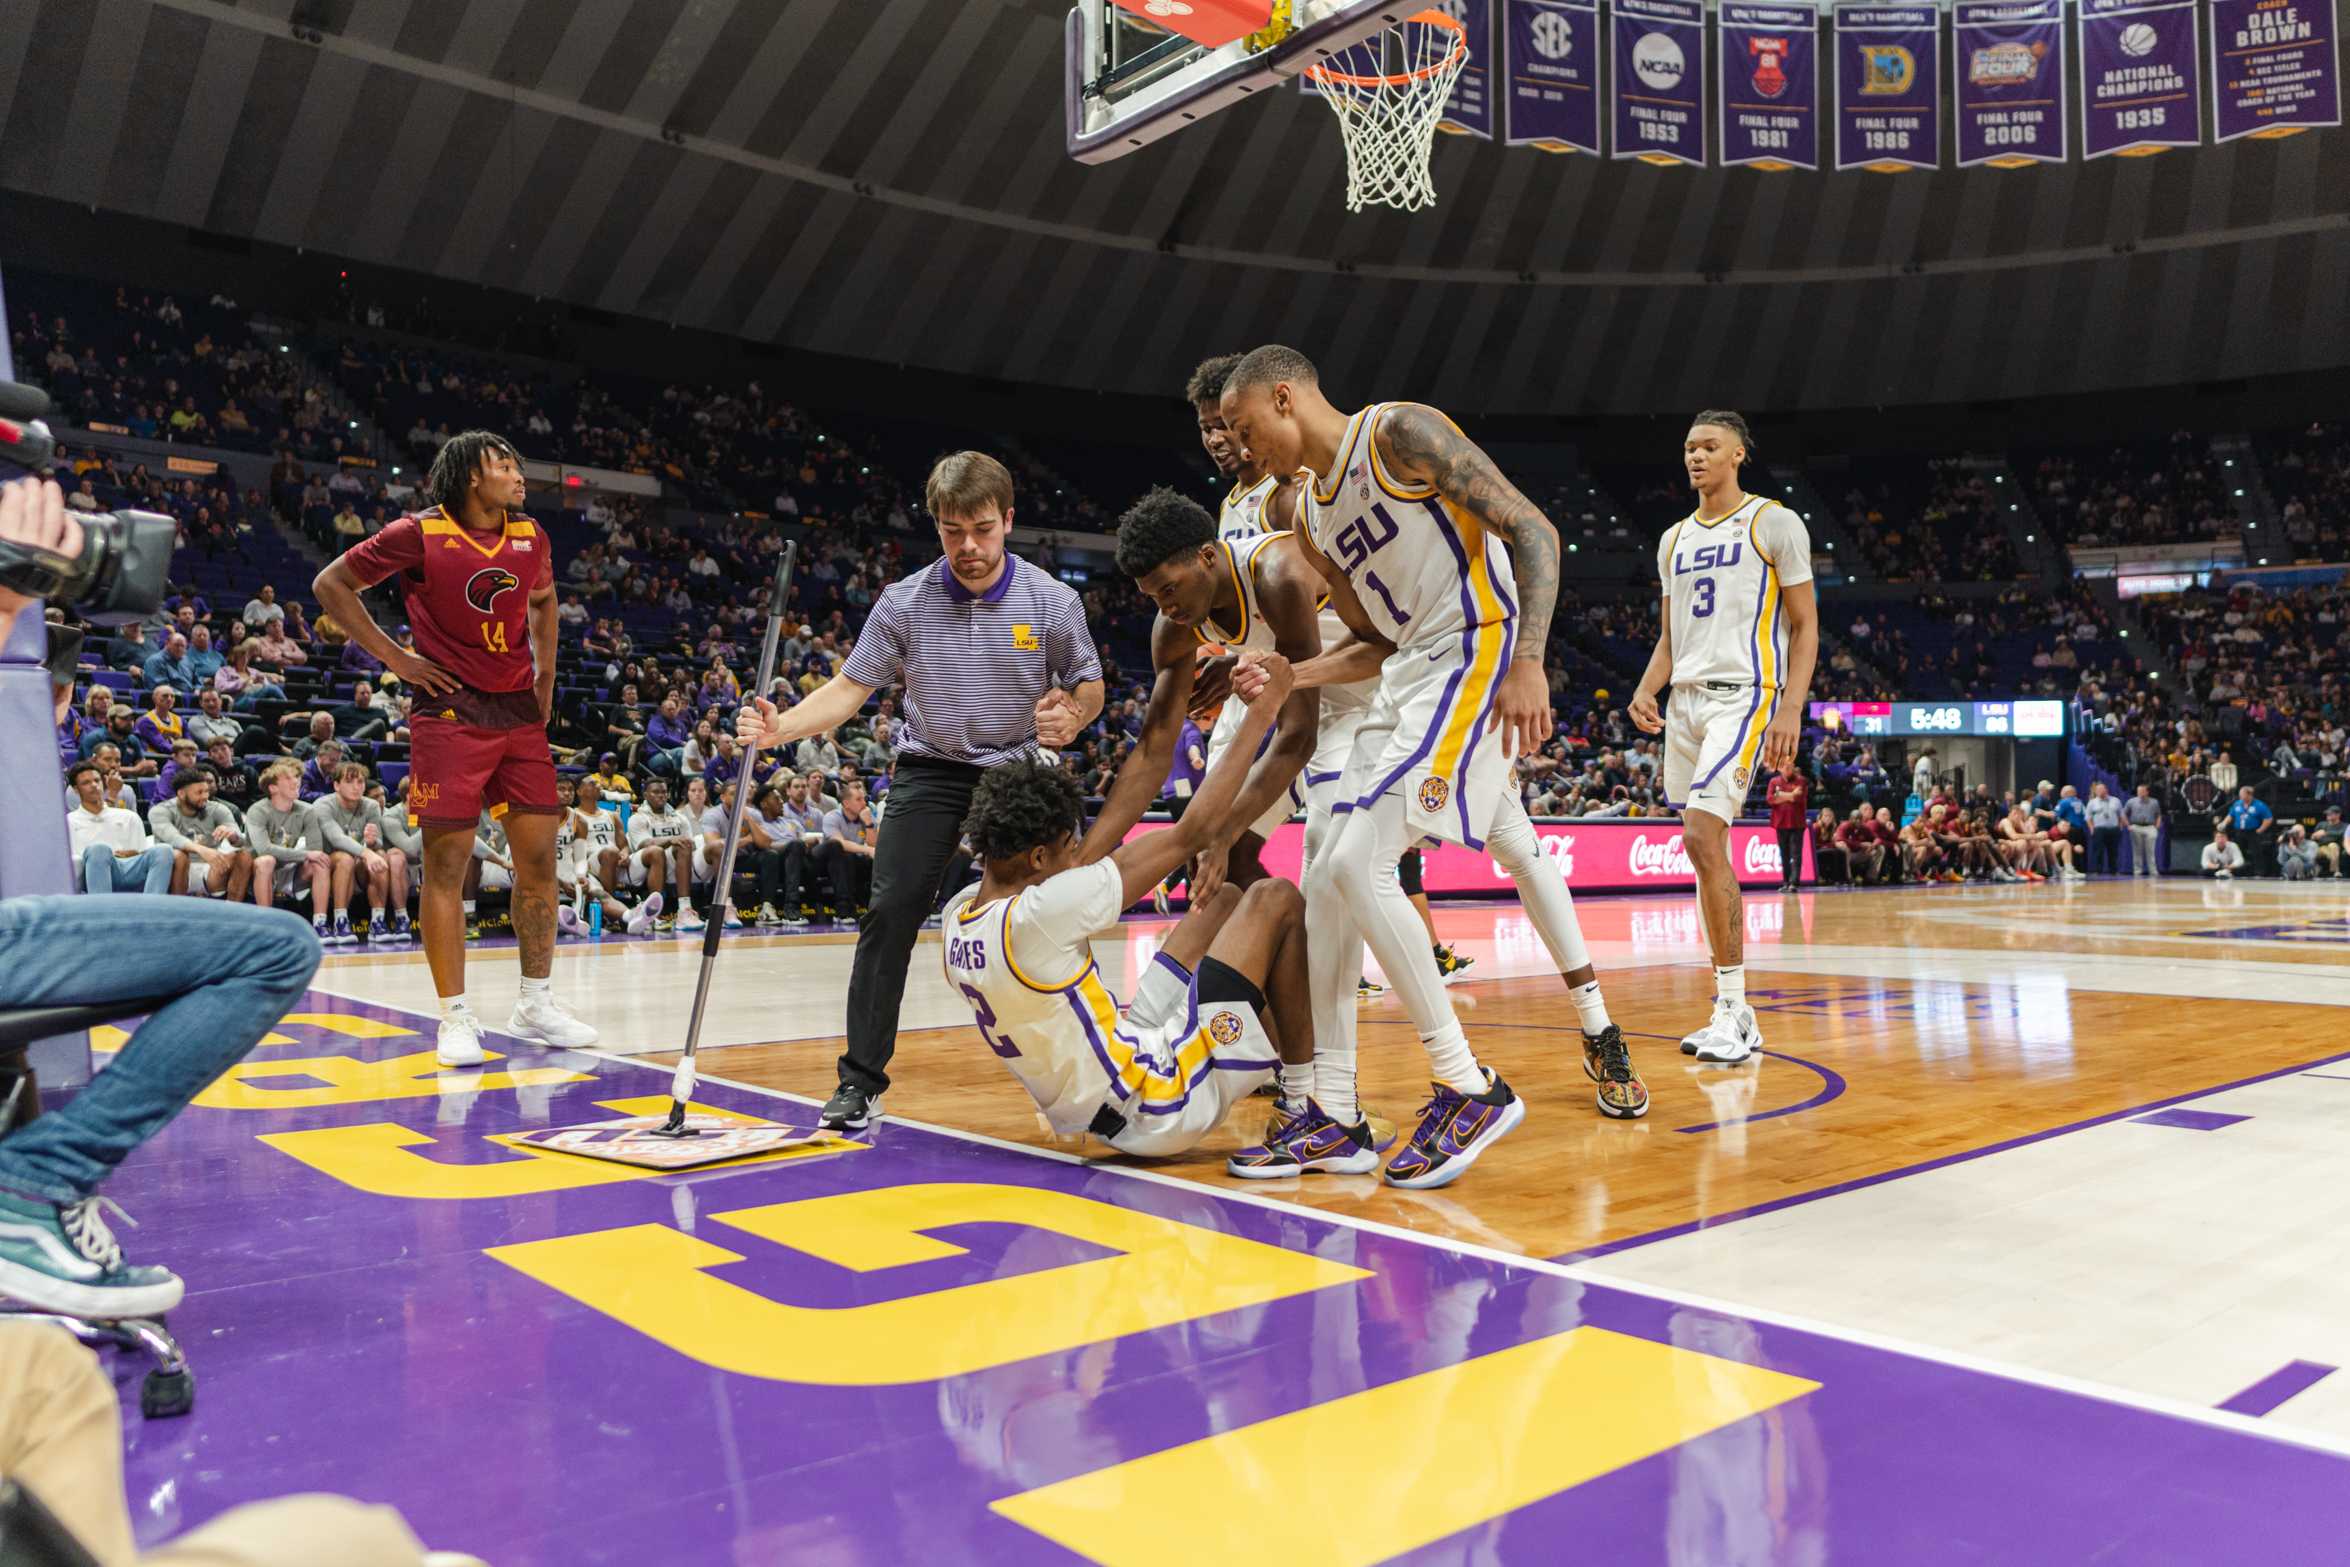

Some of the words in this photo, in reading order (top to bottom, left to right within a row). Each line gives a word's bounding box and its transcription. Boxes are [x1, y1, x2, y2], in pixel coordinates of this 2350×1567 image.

[2248, 8, 2298, 29] DALE
[2236, 21, 2311, 47] BROWN
[1640, 59, 1683, 76] NCAA
[2105, 64, 2175, 83] NATIONAL
[2097, 76, 2184, 98] CHAMPIONS
[1630, 106, 1659, 120] FINAL
[1660, 109, 1688, 123] FOUR
[1739, 114, 1769, 127] FINAL
[1771, 116, 1800, 129] FOUR
[1855, 117, 1887, 129] FINAL
[1889, 117, 1920, 129] FOUR
[1976, 112, 2010, 125] FINAL
[2012, 110, 2044, 123] FOUR
[2116, 107, 2165, 129] 1935
[1639, 121, 1679, 142] 1953
[1750, 129, 1788, 148] 1981
[1866, 131, 1910, 149] 1986
[1984, 125, 2036, 146] 2006
[1675, 543, 1742, 576] LSU
[1365, 569, 1411, 626] 1
[1692, 576, 1716, 618] 3
[481, 621, 509, 652] 14
[1910, 708, 1963, 730] 5:48
[1982, 703, 2009, 715] LSU
[1865, 717, 1883, 732] 31
[652, 826, 681, 838] LSU
[959, 982, 1023, 1058] 2
